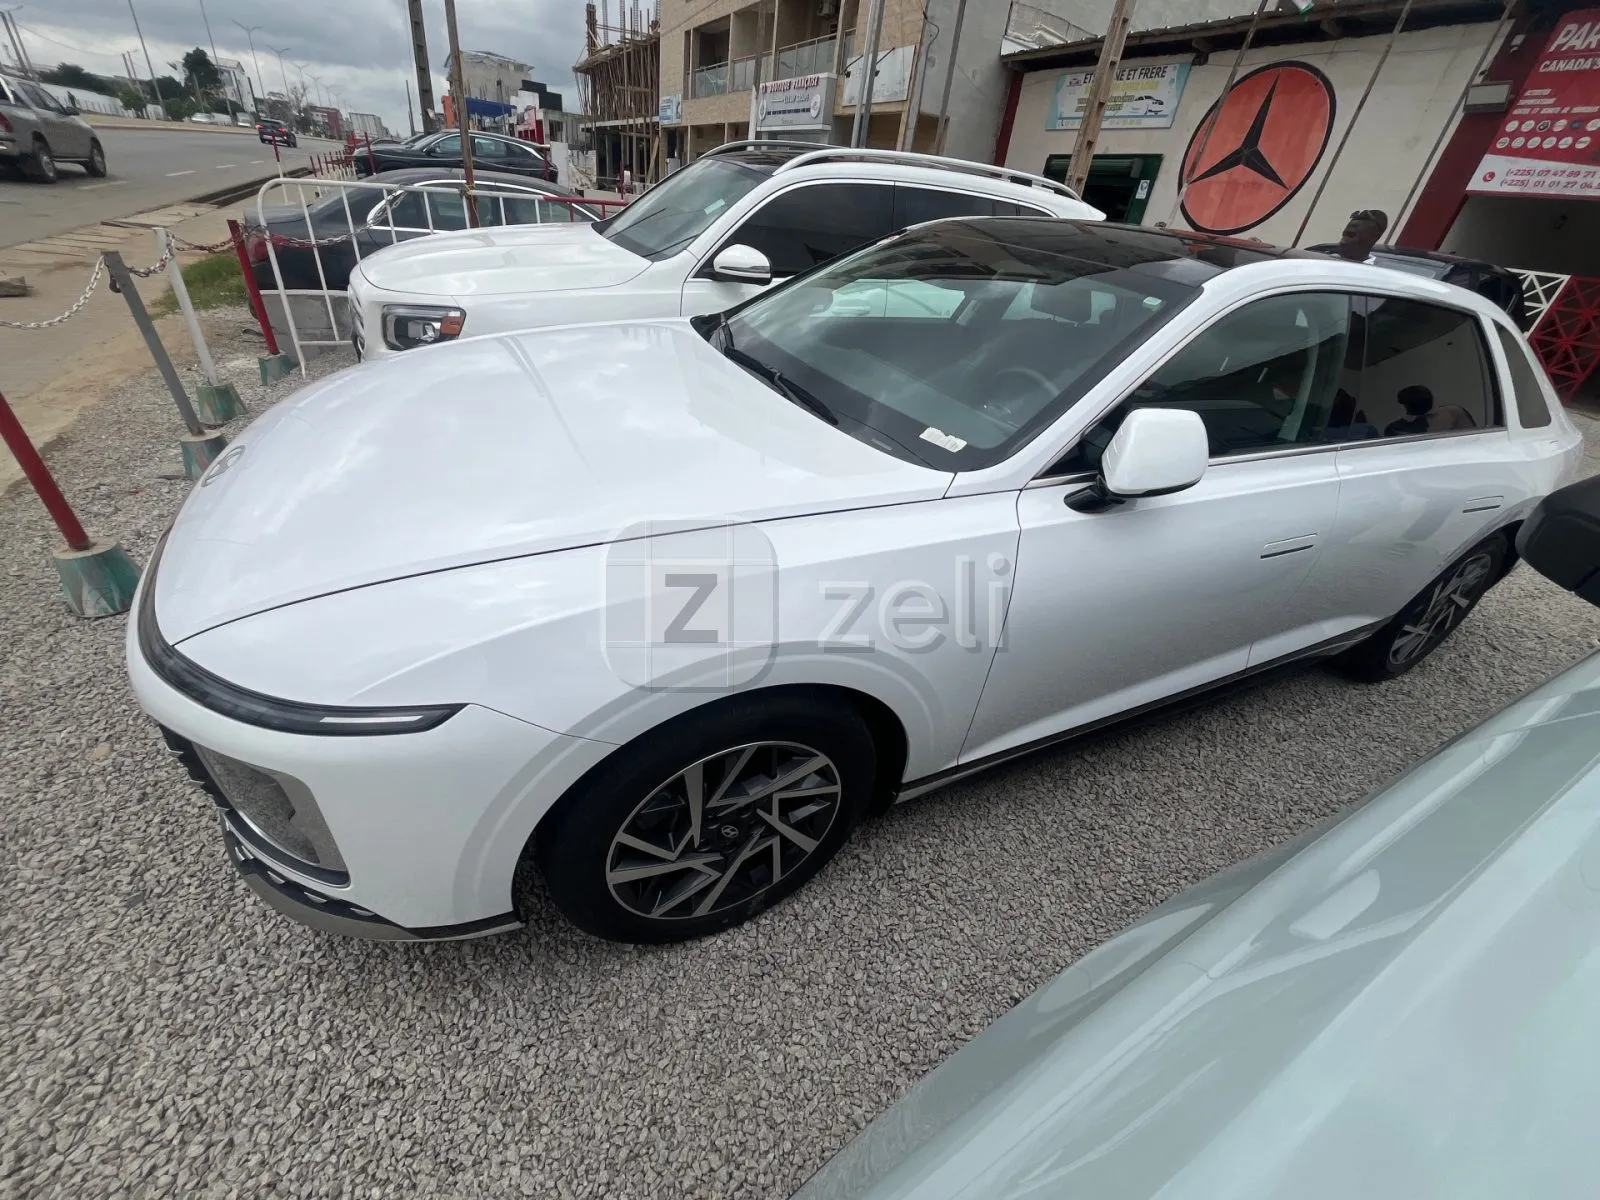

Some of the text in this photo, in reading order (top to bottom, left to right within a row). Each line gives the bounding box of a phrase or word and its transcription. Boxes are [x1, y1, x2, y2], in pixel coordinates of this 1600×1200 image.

[1127, 68, 1138, 80] ET
[1537, 169, 1550, 177] 07
[1548, 180, 1560, 188] 01
